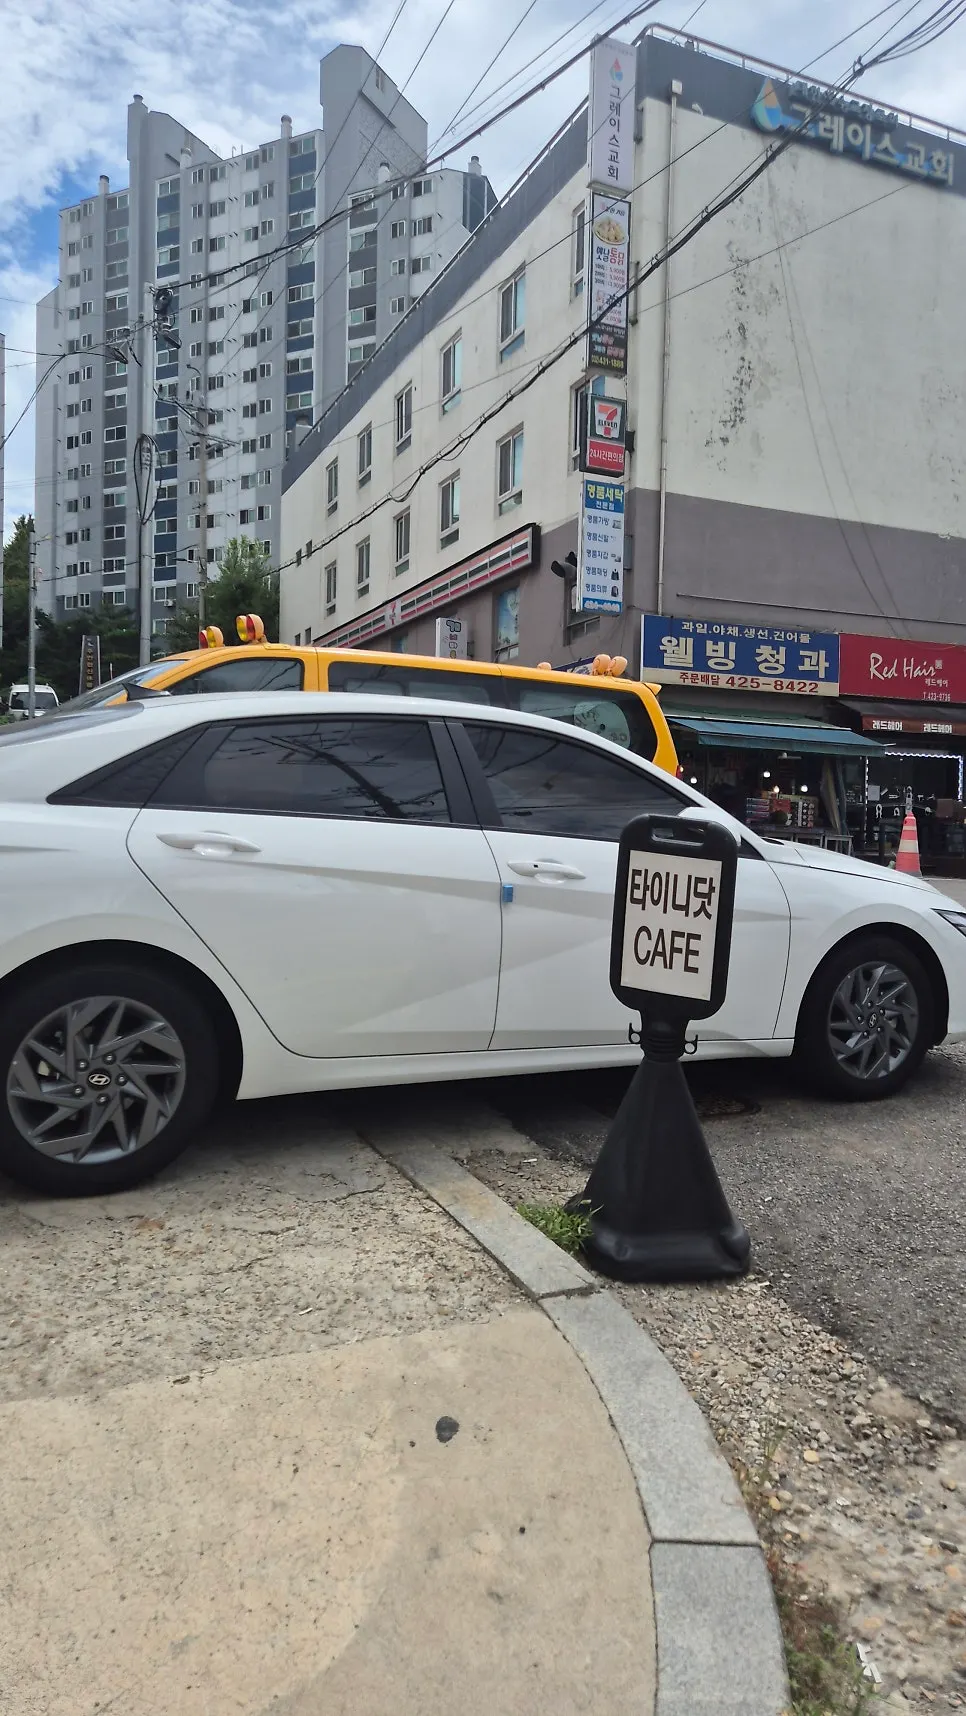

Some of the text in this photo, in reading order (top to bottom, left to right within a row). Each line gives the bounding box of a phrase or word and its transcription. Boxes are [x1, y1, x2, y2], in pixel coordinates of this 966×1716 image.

[607, 84, 622, 181] 그레이스교회
[789, 103, 955, 187] 그레이스교회
[596, 246, 624, 265] 옛날통닭
[598, 404, 618, 438] 7
[589, 448, 624, 462] 24시간편의점
[587, 484, 624, 503] 명품세탁
[681, 621, 812, 645] 과일.야채.생선.건어물
[869, 652, 936, 681] Red Hair
[679, 671, 820, 694] 주문배달 425-8422
[872, 720, 953, 734] 레드헤어 레드헤어
[629, 868, 716, 920] 타이니닷
[633, 925, 702, 974] CAFE
